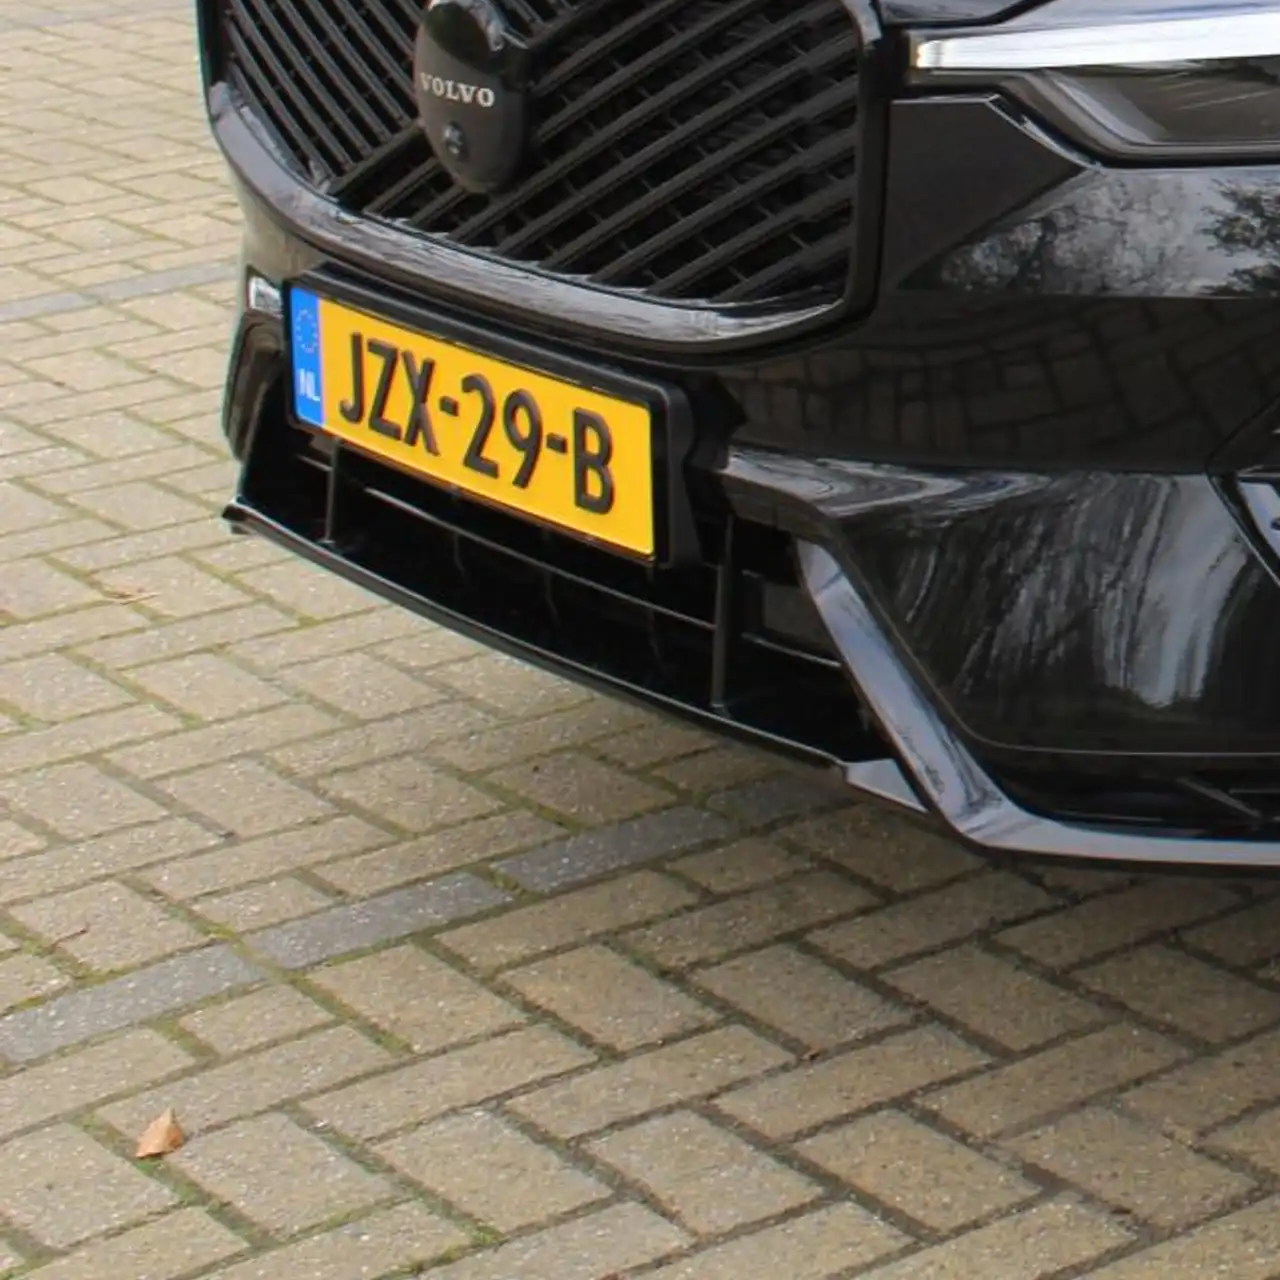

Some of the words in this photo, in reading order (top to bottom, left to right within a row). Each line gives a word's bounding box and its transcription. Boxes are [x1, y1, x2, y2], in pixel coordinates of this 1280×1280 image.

[419, 72, 495, 108] VOLVO
[296, 367, 321, 402] NL
[339, 331, 615, 515] JZX-29-B
